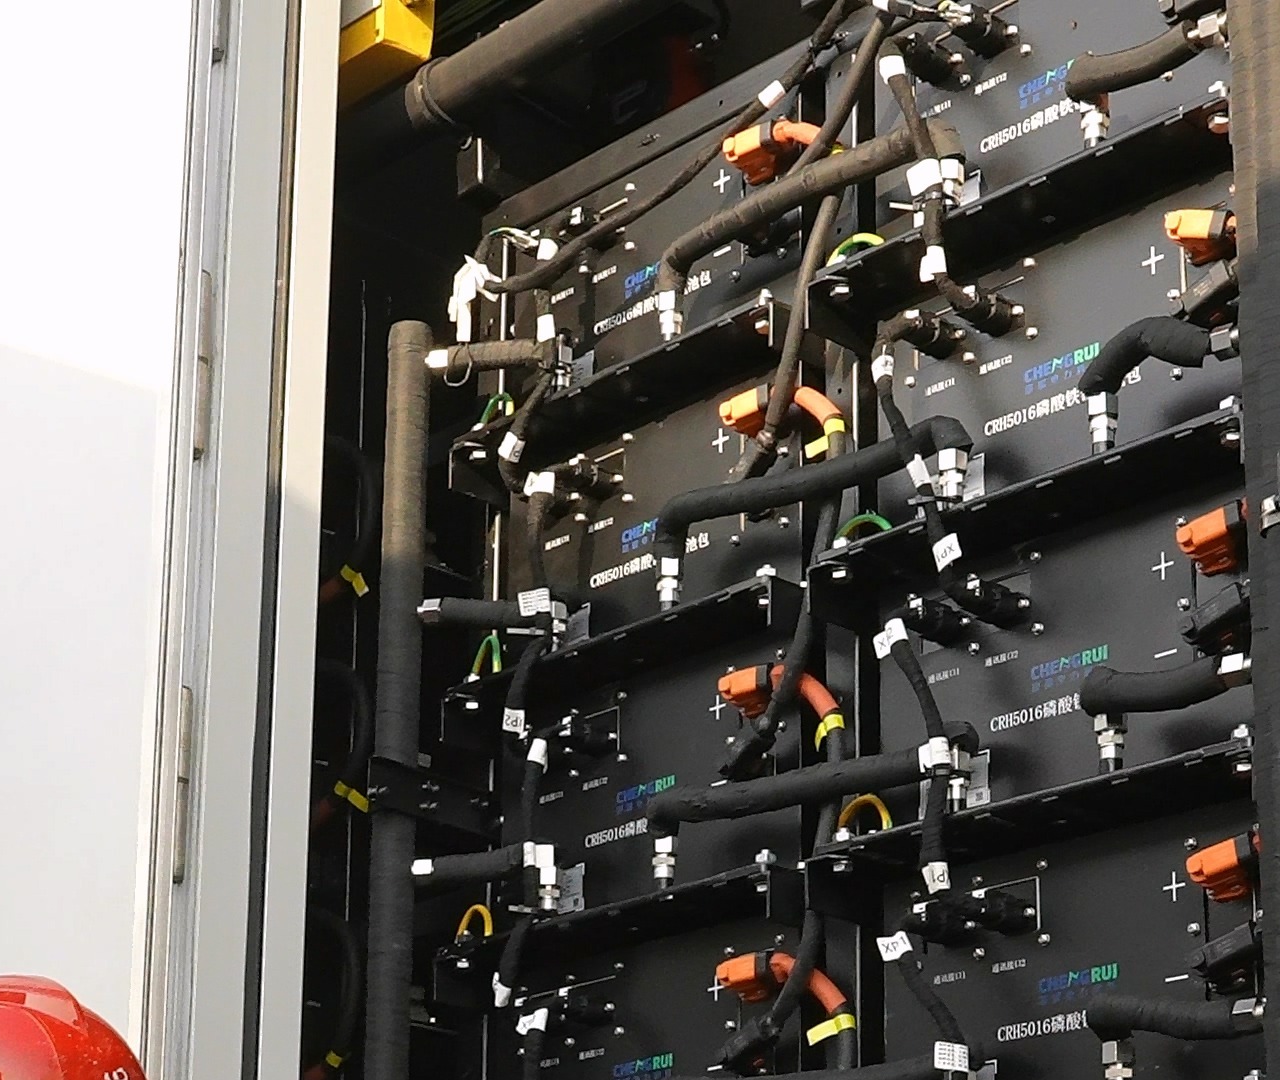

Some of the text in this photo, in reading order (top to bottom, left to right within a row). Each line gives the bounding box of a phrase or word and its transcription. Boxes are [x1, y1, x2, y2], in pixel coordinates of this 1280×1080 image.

[1024, 342, 1101, 384] CHENGRUI
[1031, 645, 1109, 680] CHENGRUI
[881, 935, 907, 956] XP1
[1039, 963, 1118, 993] CHENGRUI
